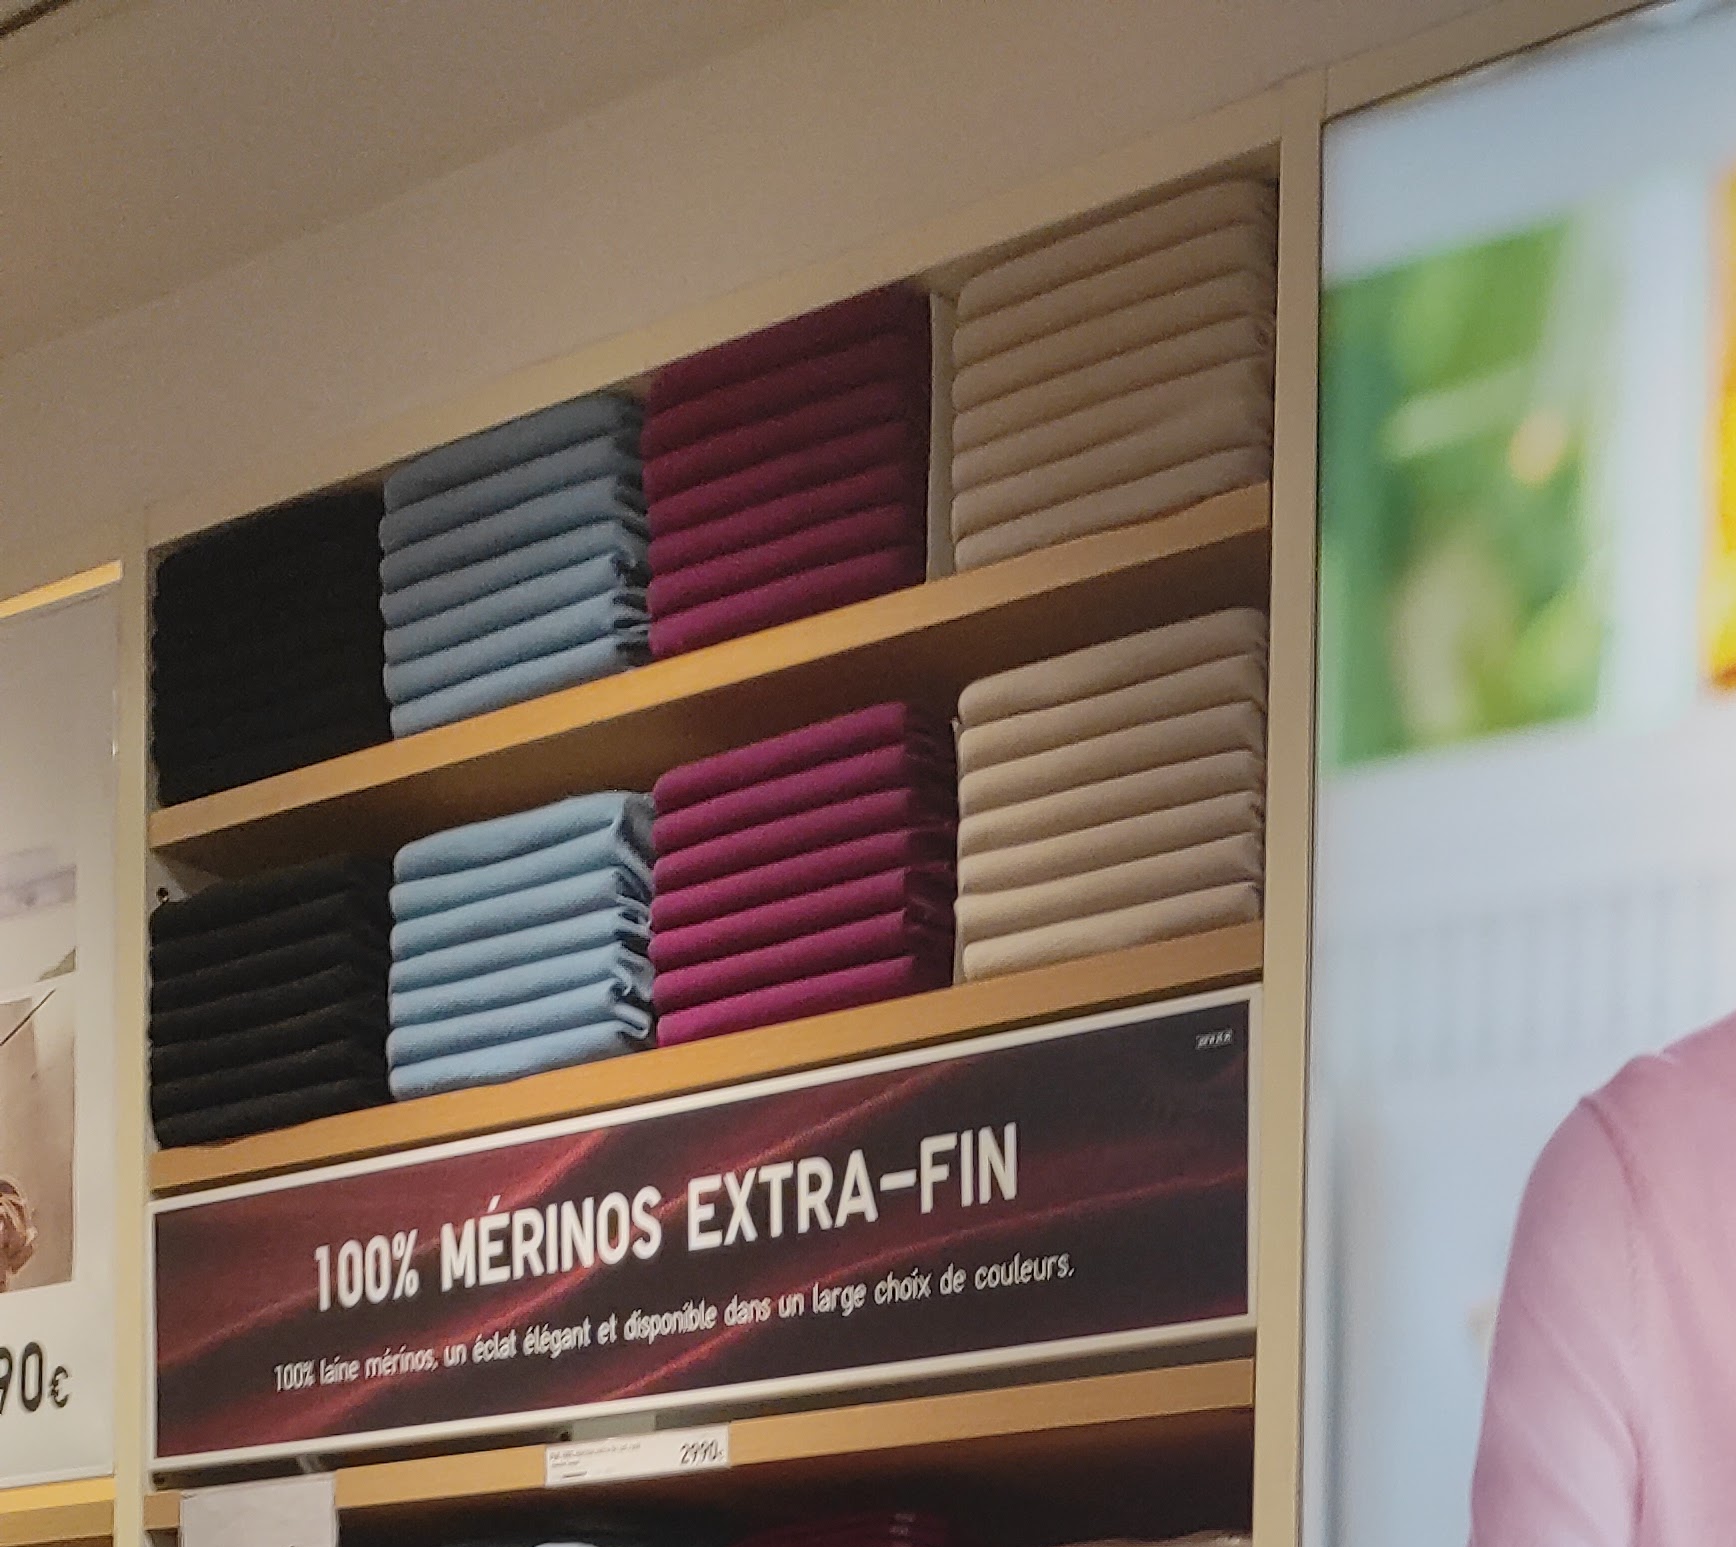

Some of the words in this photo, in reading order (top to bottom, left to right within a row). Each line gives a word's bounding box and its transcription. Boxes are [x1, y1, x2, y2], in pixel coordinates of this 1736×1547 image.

[314, 1228, 420, 1312] 100%
[440, 1185, 662, 1293] MÉRINOS
[687, 1121, 1018, 1252] EXTRA-FIN
[273, 1360, 315, 1392] 100%
[319, 1358, 359, 1387] laine
[443, 1345, 467, 1367] un
[472, 1334, 517, 1364] éclat
[523, 1316, 592, 1360] élégant
[597, 1312, 618, 1345] et
[624, 1297, 717, 1344] disponible
[723, 1295, 771, 1327] dans
[778, 1293, 805, 1318] un
[812, 1282, 866, 1317] large
[874, 1268, 932, 1304] choix
[939, 1263, 966, 1294] de
